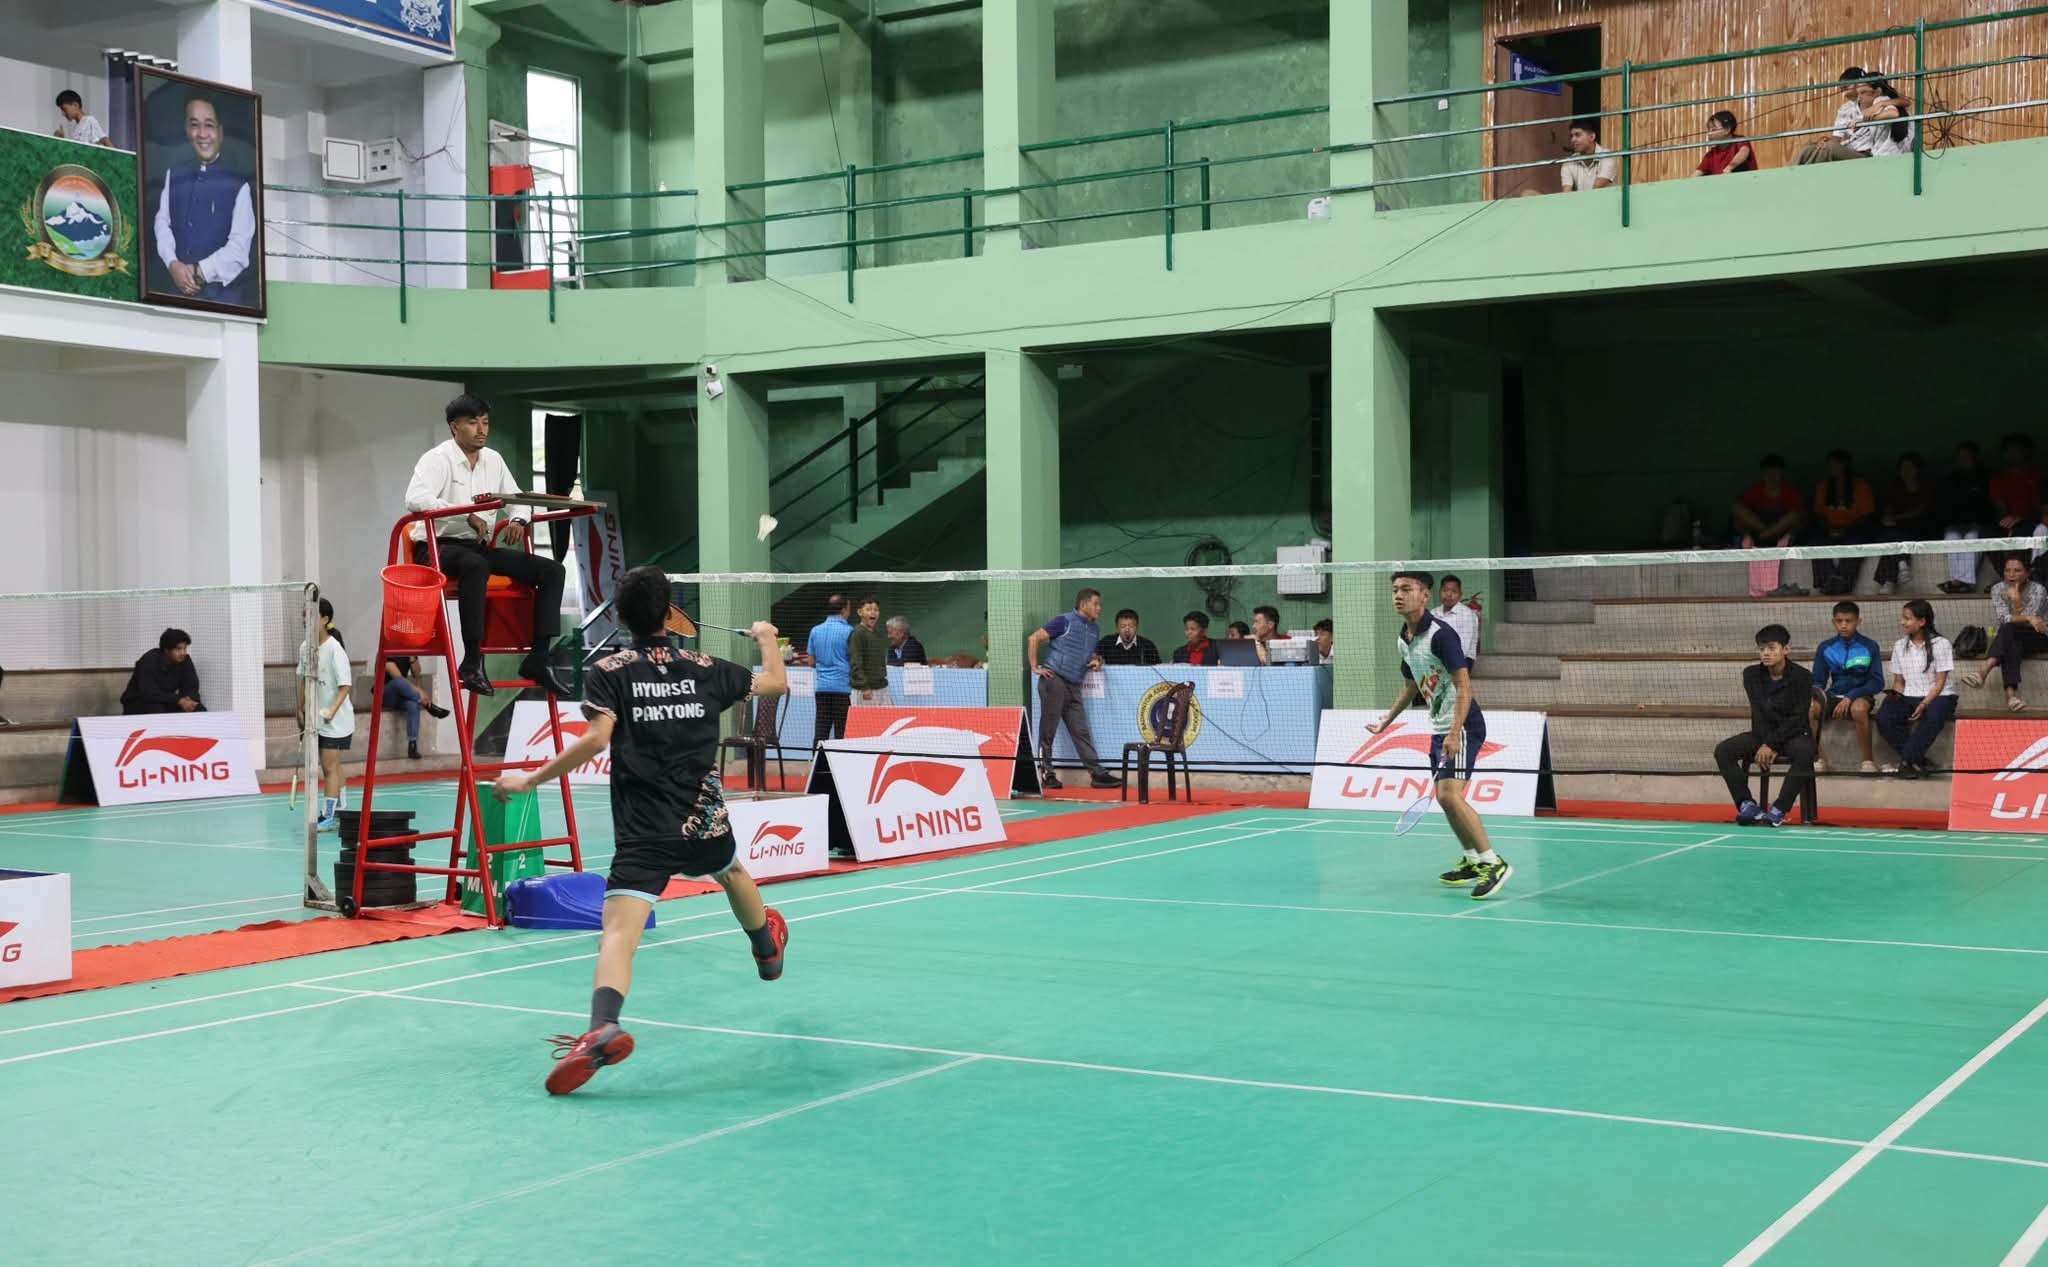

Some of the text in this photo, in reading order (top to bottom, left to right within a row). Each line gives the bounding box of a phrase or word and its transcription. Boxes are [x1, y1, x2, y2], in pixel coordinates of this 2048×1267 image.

[604, 511, 622, 583] NING
[631, 678, 697, 698] HYURSEY
[631, 702, 705, 722] PAKYONG
[119, 761, 230, 788] LI-NING
[875, 805, 983, 844] LI-NING
[749, 841, 806, 860] LI-NING
[518, 853, 526, 870] 2
